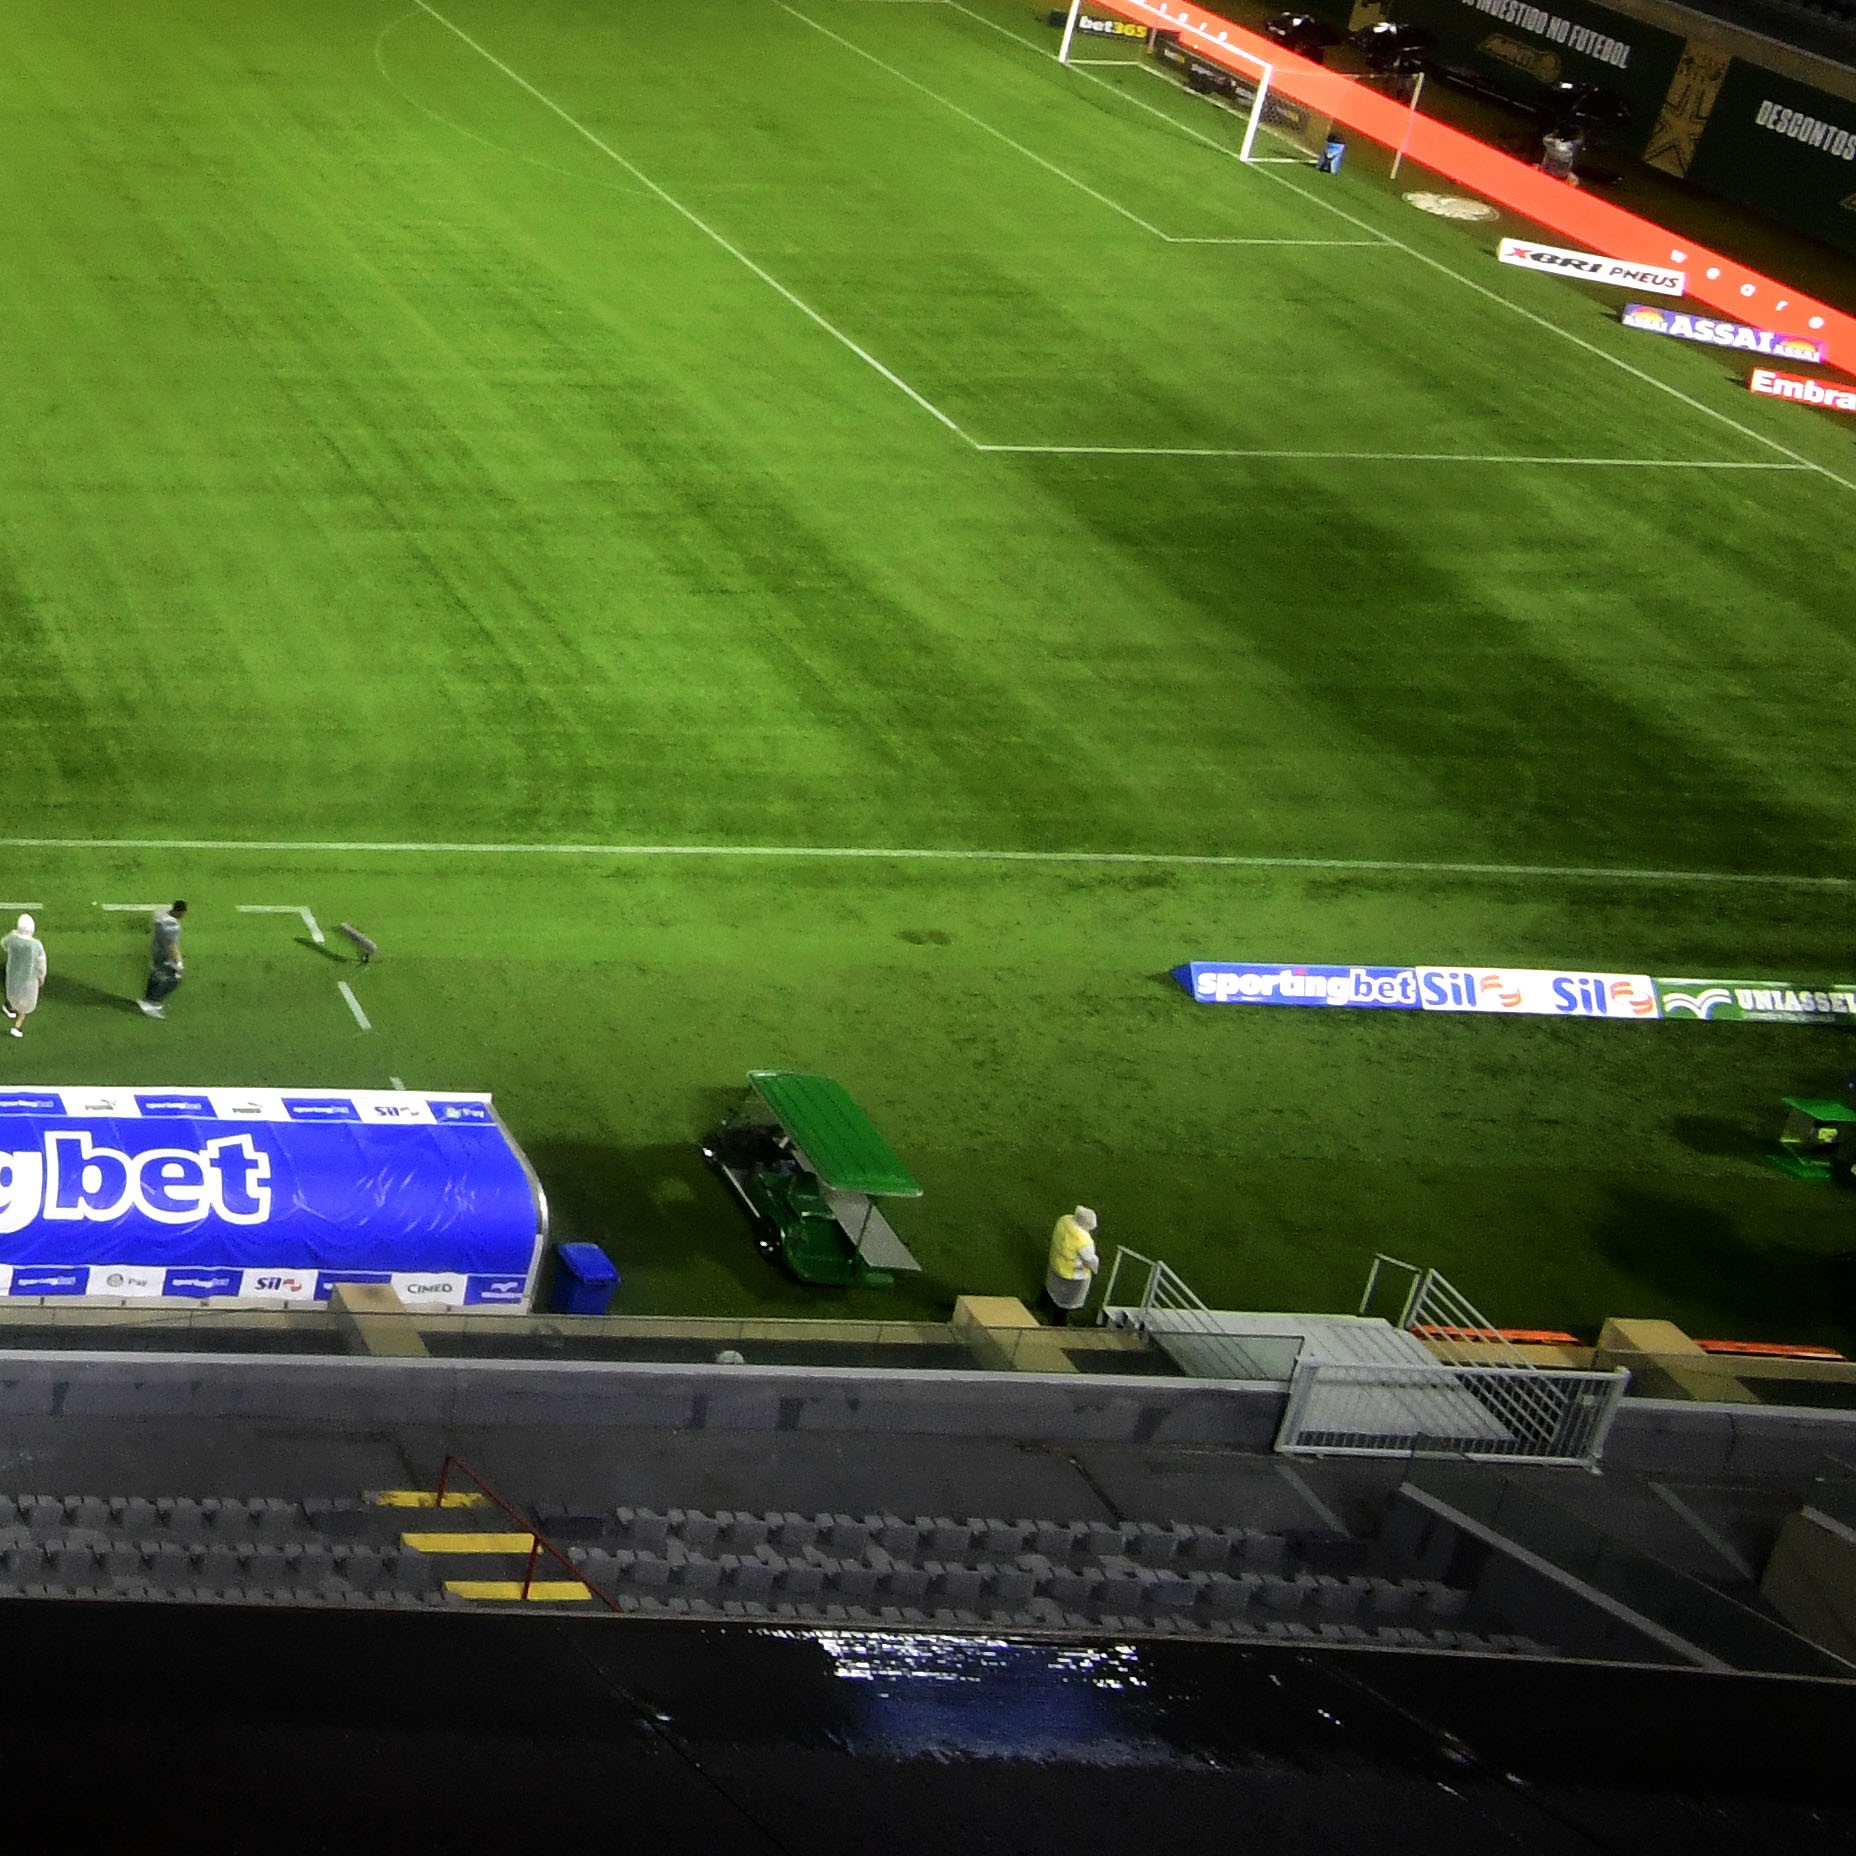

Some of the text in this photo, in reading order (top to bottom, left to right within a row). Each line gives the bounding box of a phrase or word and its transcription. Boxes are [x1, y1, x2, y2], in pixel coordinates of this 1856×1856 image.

[1079, 14, 1149, 38] bet365
[1754, 99, 1856, 161] DESCONTOS
[1608, 266, 1680, 289] PNEUS
[1196, 966, 1420, 1004] sportingbet
[1423, 971, 1478, 1008] Sil
[1553, 976, 1607, 1015] Sil
[254, 1276, 282, 1292] Sil
[406, 1282, 453, 1295] CIMED
